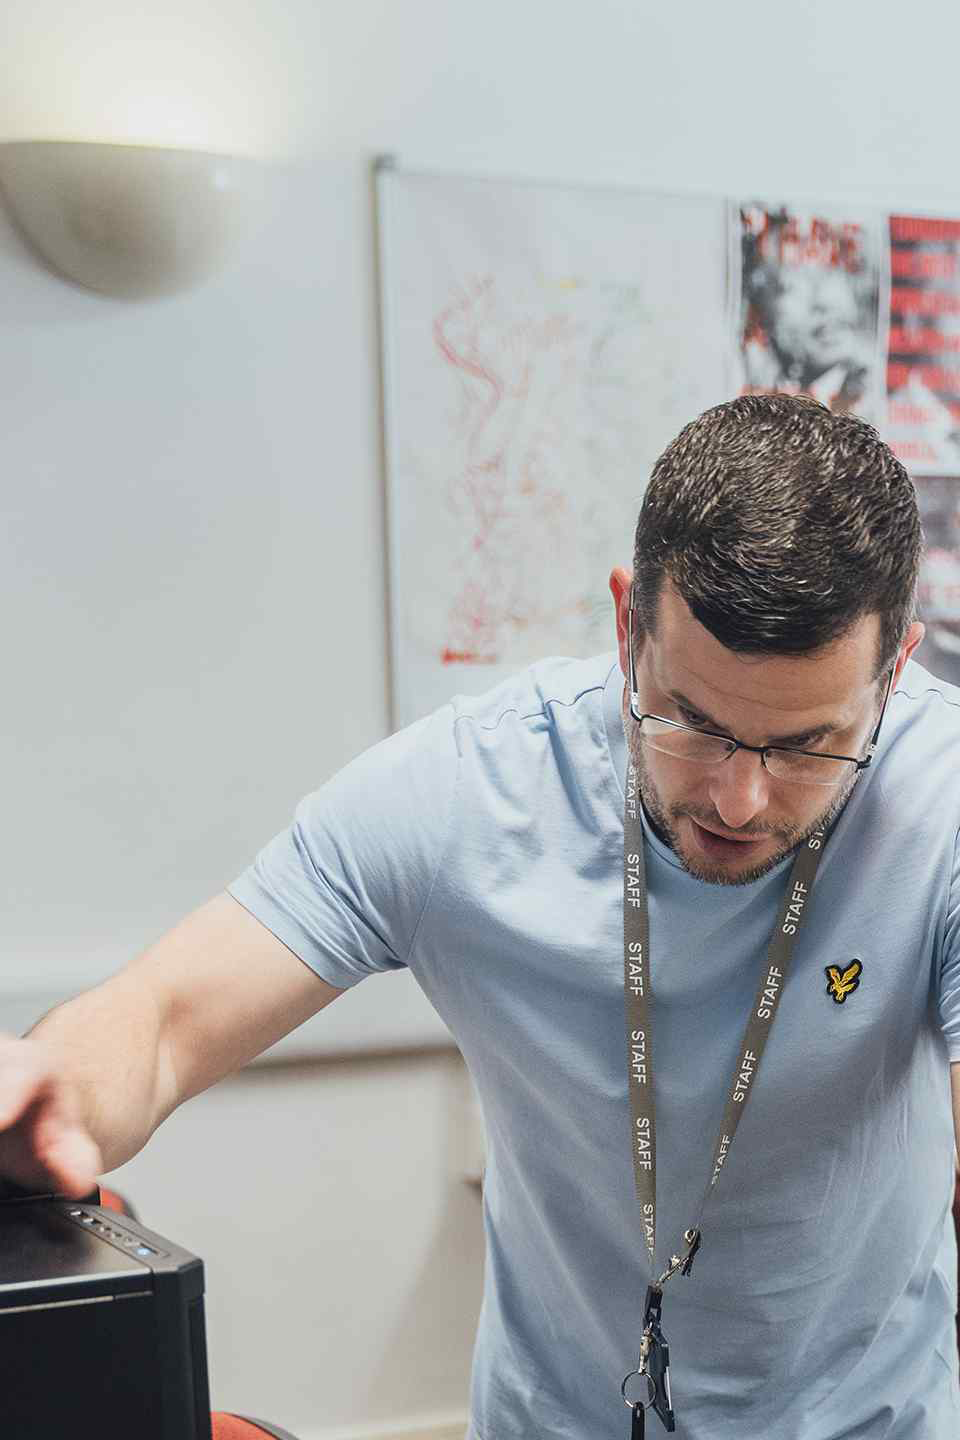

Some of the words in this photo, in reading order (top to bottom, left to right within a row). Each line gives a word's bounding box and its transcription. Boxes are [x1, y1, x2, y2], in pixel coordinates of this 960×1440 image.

[627, 853, 641, 908] STAFF
[782, 881, 808, 935] STAFF
[628, 942, 644, 997] STAFF
[757, 966, 784, 1019] STAFF
[631, 1030, 647, 1084] STAFF
[732, 1050, 757, 1103] STAFF
[636, 1117, 652, 1171] STAFF
